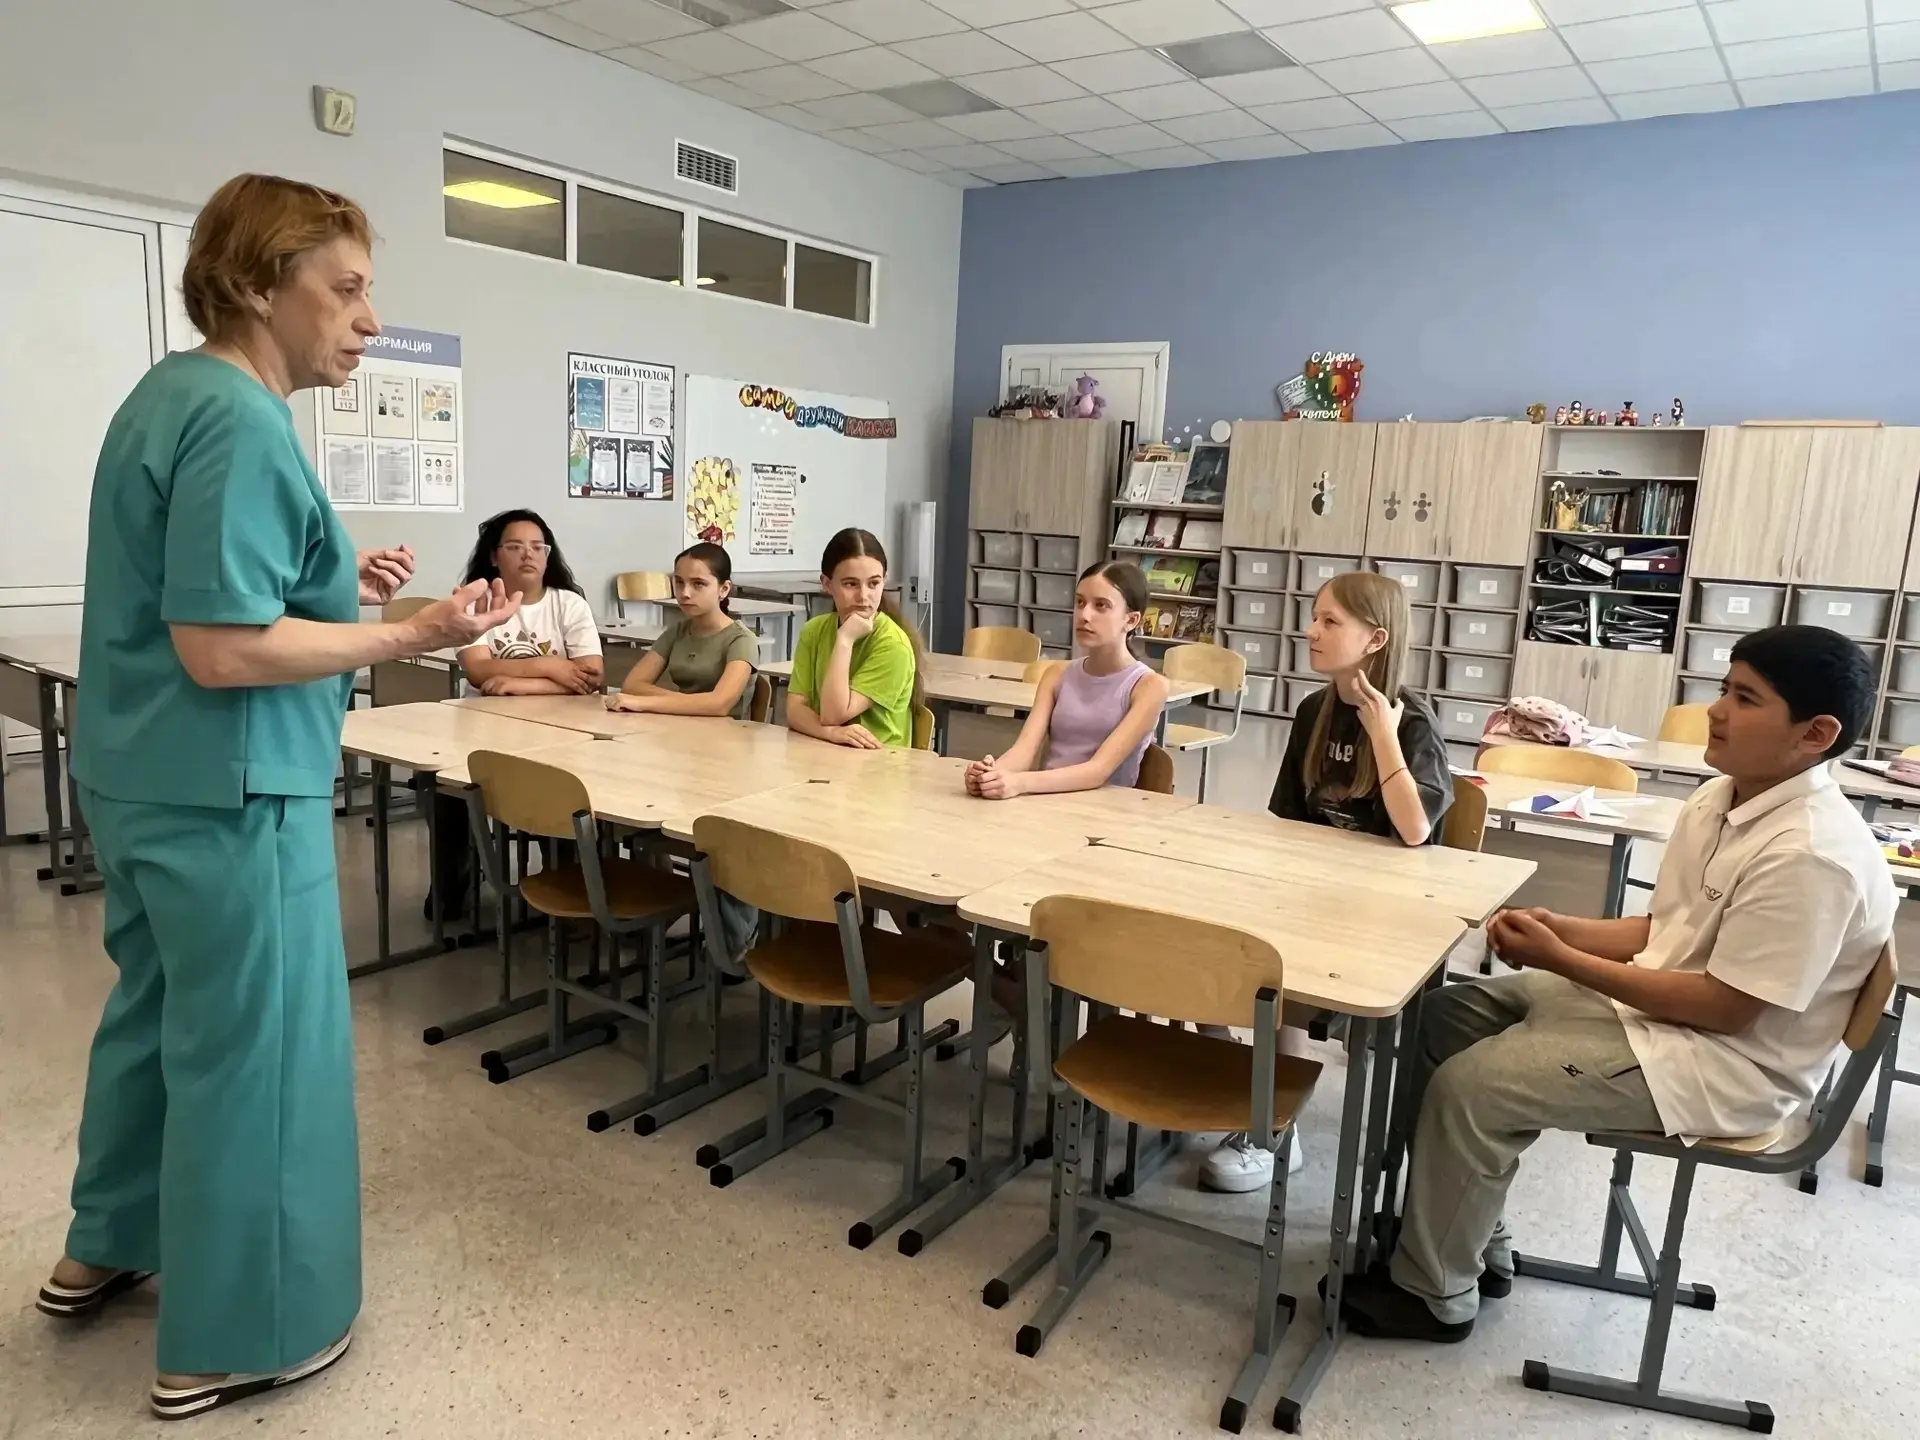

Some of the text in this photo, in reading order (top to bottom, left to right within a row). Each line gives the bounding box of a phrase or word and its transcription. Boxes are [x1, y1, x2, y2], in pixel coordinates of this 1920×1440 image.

[364, 335, 432, 354] ФОРМАЦИЯ
[573, 360, 671, 382] КЛАССНЫЙ УГОЛОК
[341, 389, 350, 397] 01
[340, 401, 353, 409] 112
